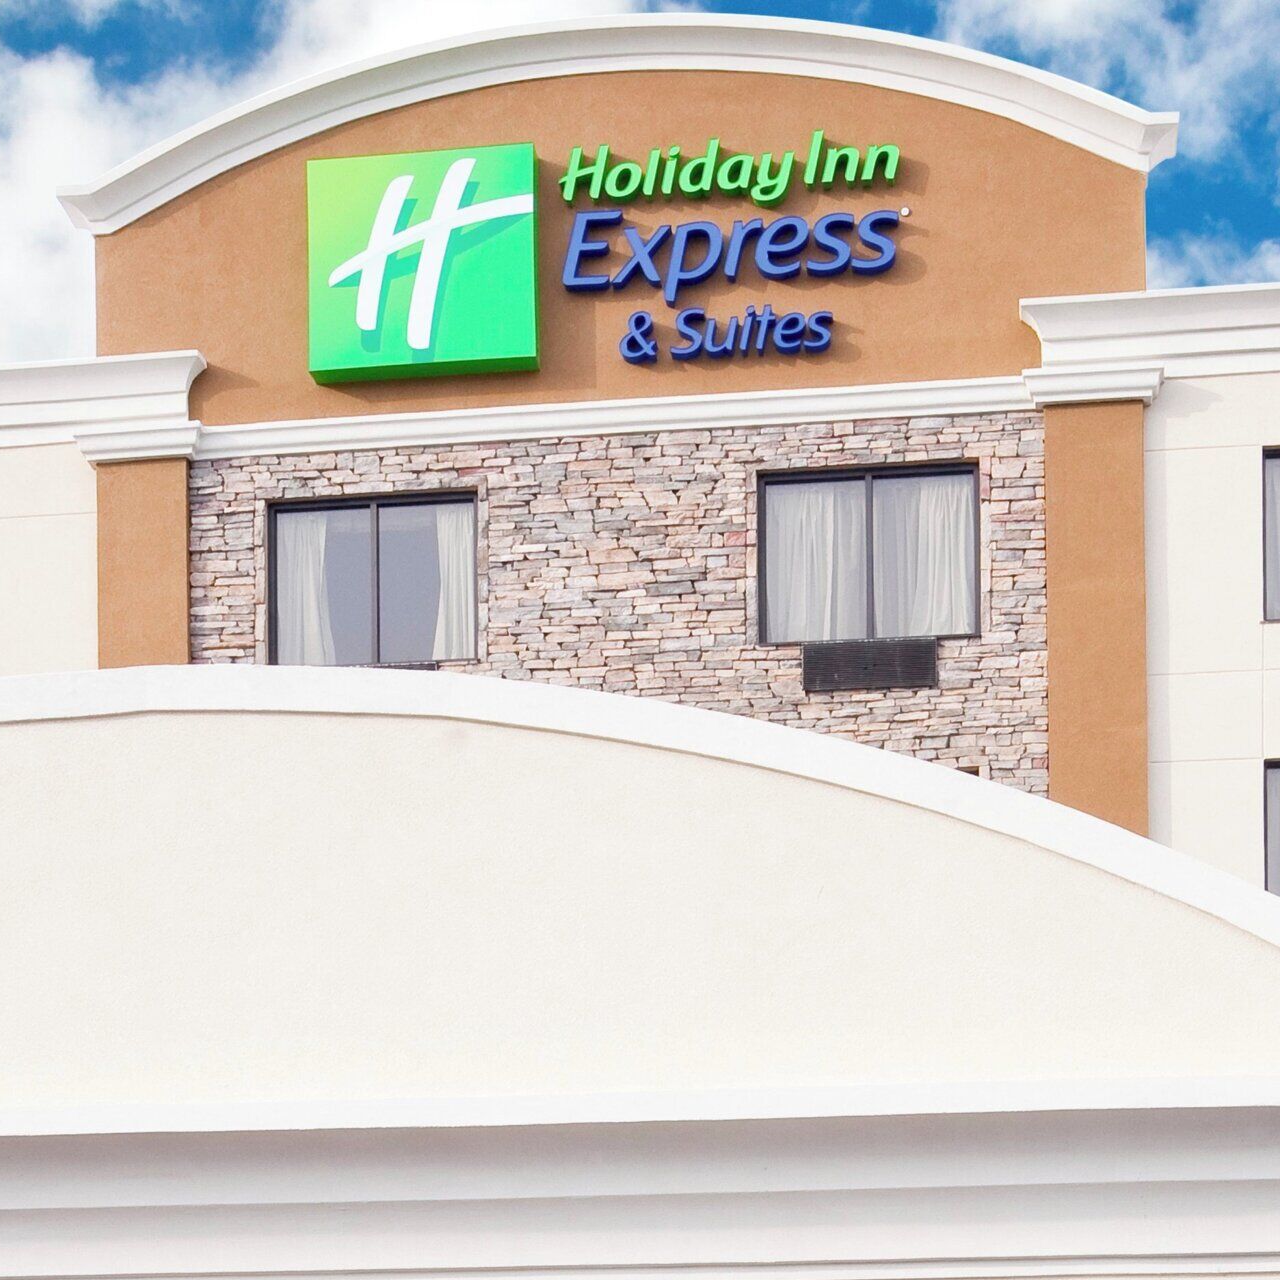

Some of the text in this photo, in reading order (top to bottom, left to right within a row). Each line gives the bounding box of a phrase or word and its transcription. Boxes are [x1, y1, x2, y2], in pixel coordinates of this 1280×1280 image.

[558, 129, 900, 207] Holiday Inn
[562, 208, 899, 307] Express
[619, 304, 834, 364] & Suites
